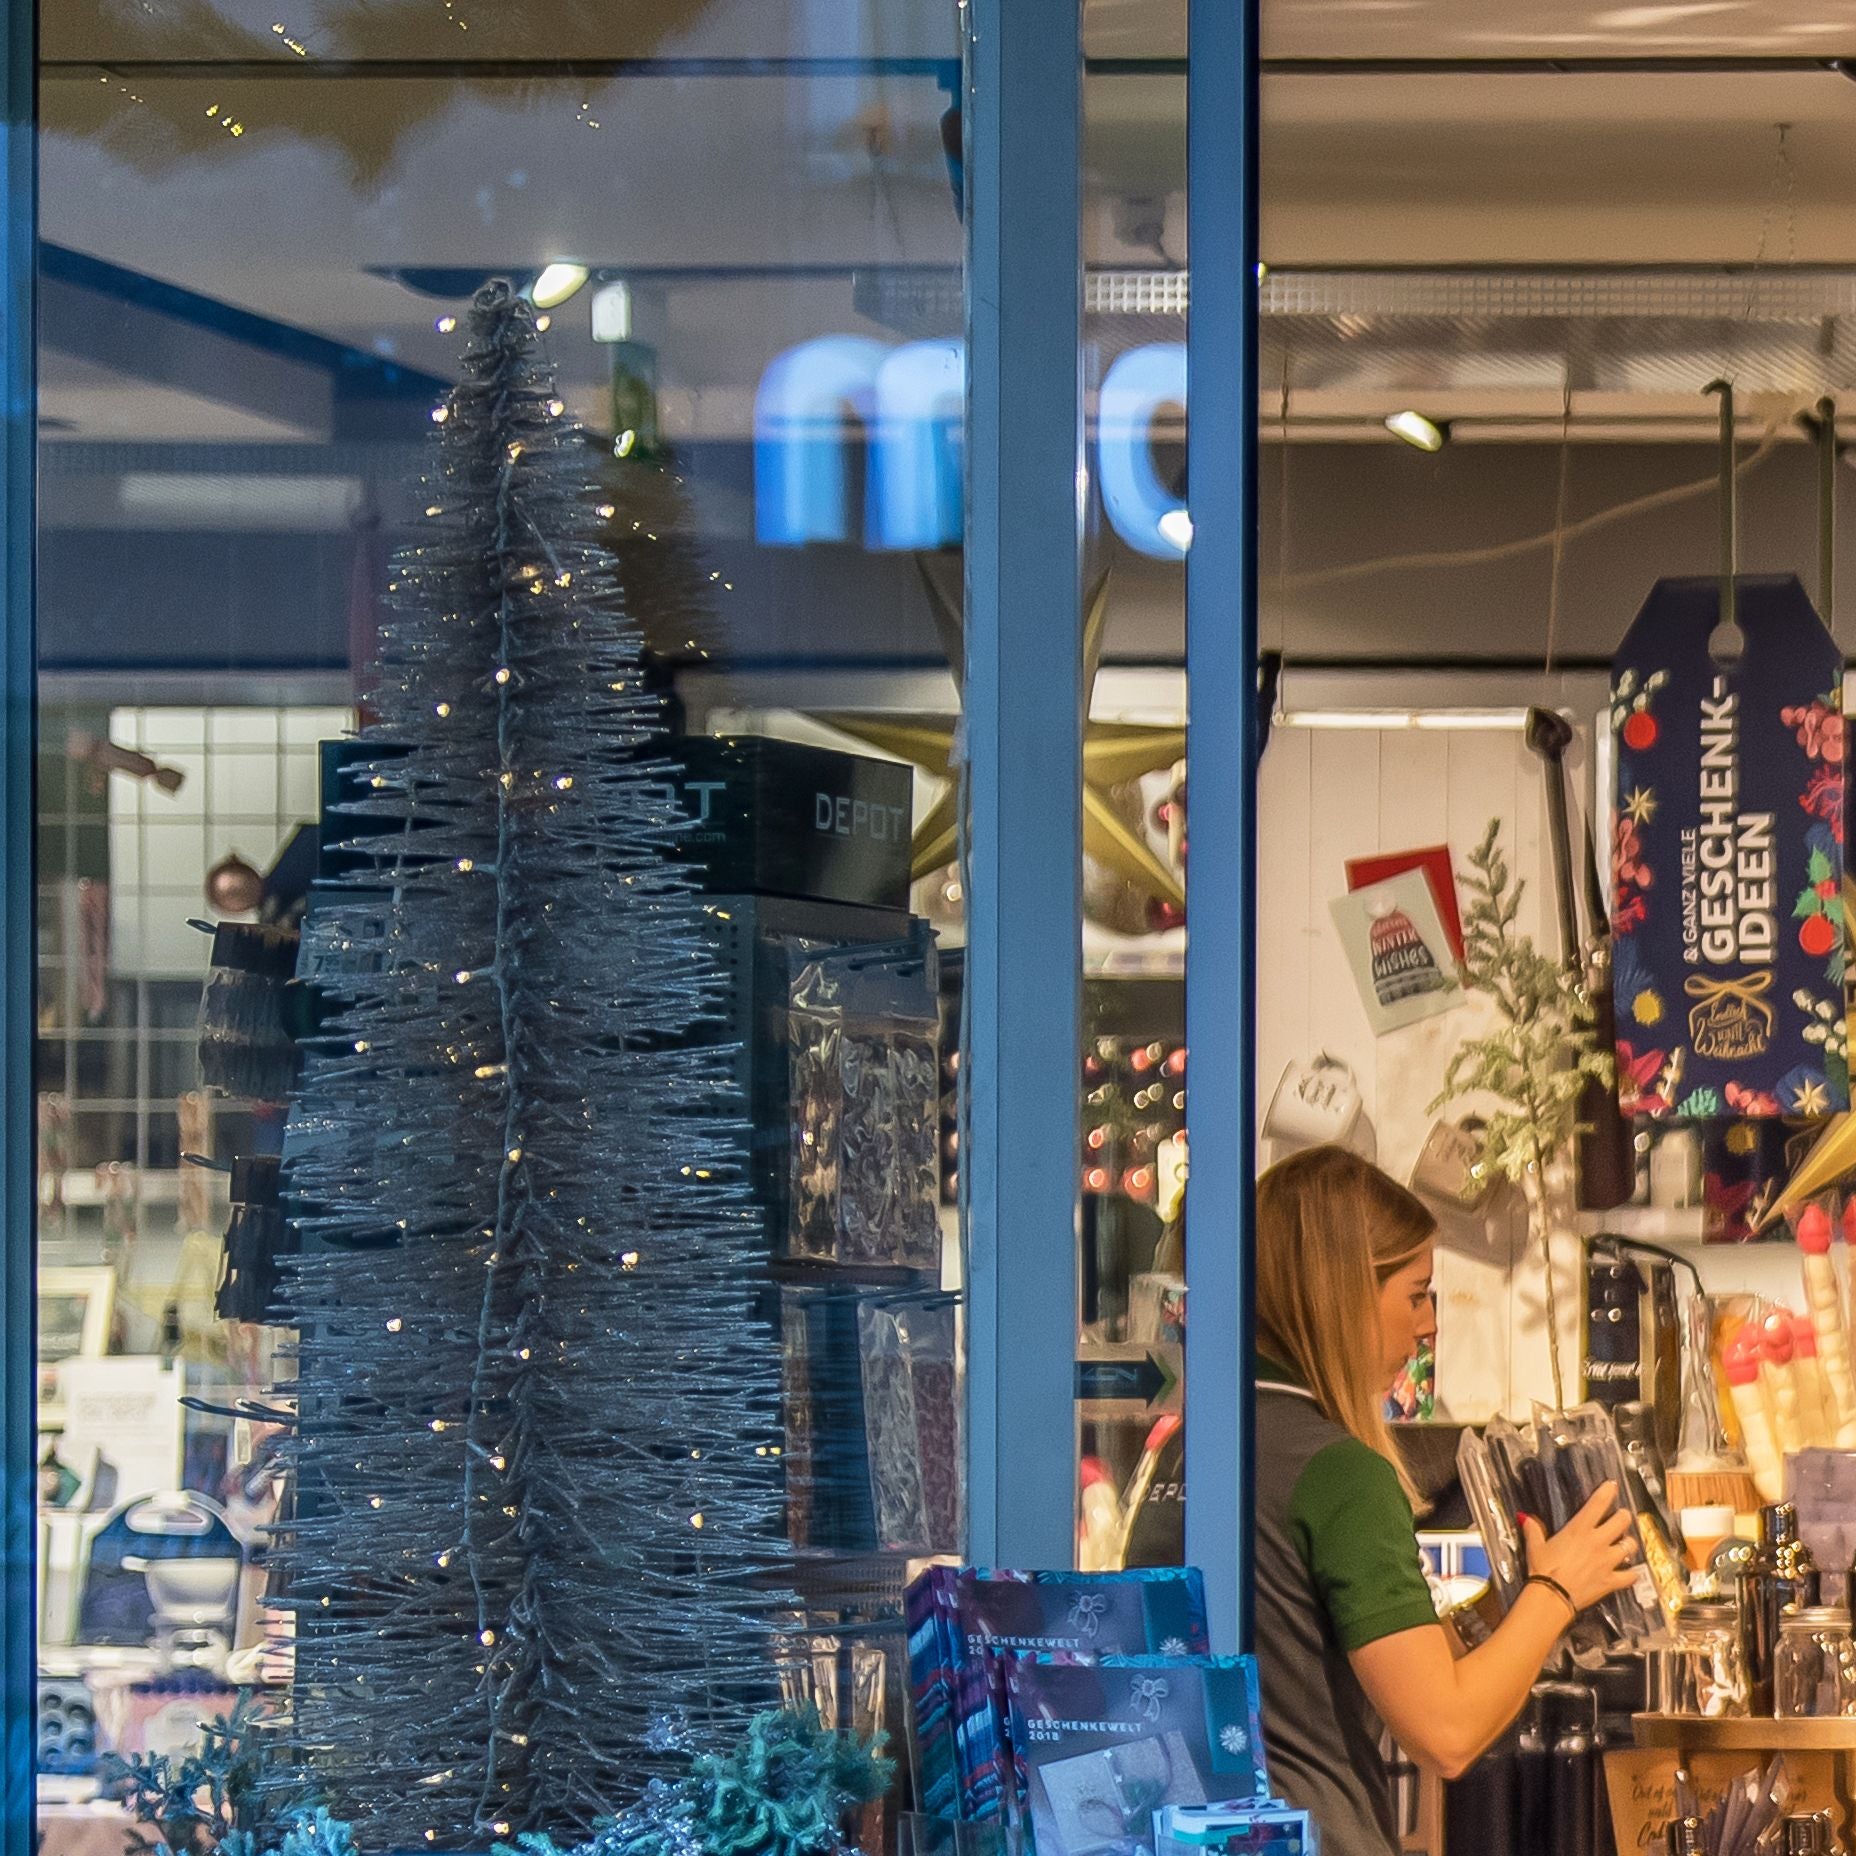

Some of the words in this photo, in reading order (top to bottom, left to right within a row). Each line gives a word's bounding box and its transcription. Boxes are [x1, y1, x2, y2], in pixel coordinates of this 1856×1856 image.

[815, 792, 905, 843] DEPOT
[1699, 675, 1738, 964] GESCHENK-
[1681, 829, 1697, 887] VIELE
[1737, 811, 1776, 964] IDEEN
[1682, 888, 1698, 943] GANZ
[1683, 944, 1698, 963] &
[967, 1634, 1080, 1648] GESCHENKEWELT
[1027, 1719, 1143, 1733] GESCHENKEWELT
[1028, 1731, 1061, 1742] 2018
